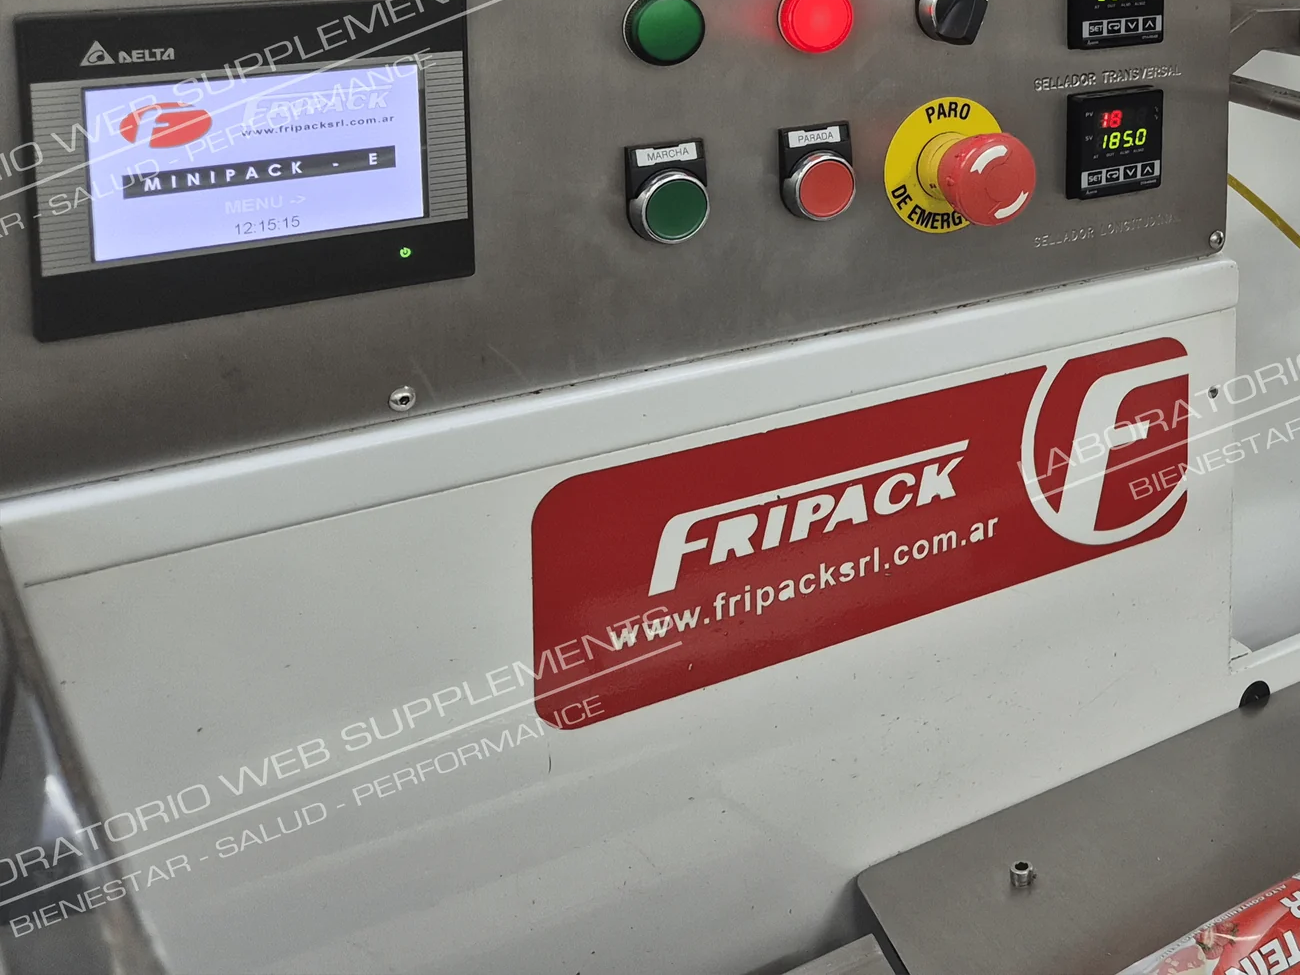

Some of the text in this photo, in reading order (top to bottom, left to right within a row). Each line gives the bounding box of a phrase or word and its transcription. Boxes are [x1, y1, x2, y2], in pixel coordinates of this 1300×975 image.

[1089, 24, 1103, 32] SET
[118, 47, 175, 64] DELTA
[1034, 65, 1182, 92] SELLADOR TRANSVERSAL
[925, 102, 972, 124] PARO
[240, 115, 395, 137] www.fripacksrl.com.ar
[797, 130, 834, 143] PARADA
[1102, 128, 1147, 149] 185.0
[647, 146, 690, 162] MARCHA
[143, 161, 303, 191] MINIPACK
[1088, 174, 1102, 182] SET
[224, 194, 284, 215] MENU
[891, 185, 967, 229] DE EMERG
[234, 215, 301, 235] 12:15:15
[1034, 228, 1095, 248] SELLADOR
[648, 439, 969, 596] FRIPACK
[609, 515, 998, 652] www.fripacksrl.com.ar
